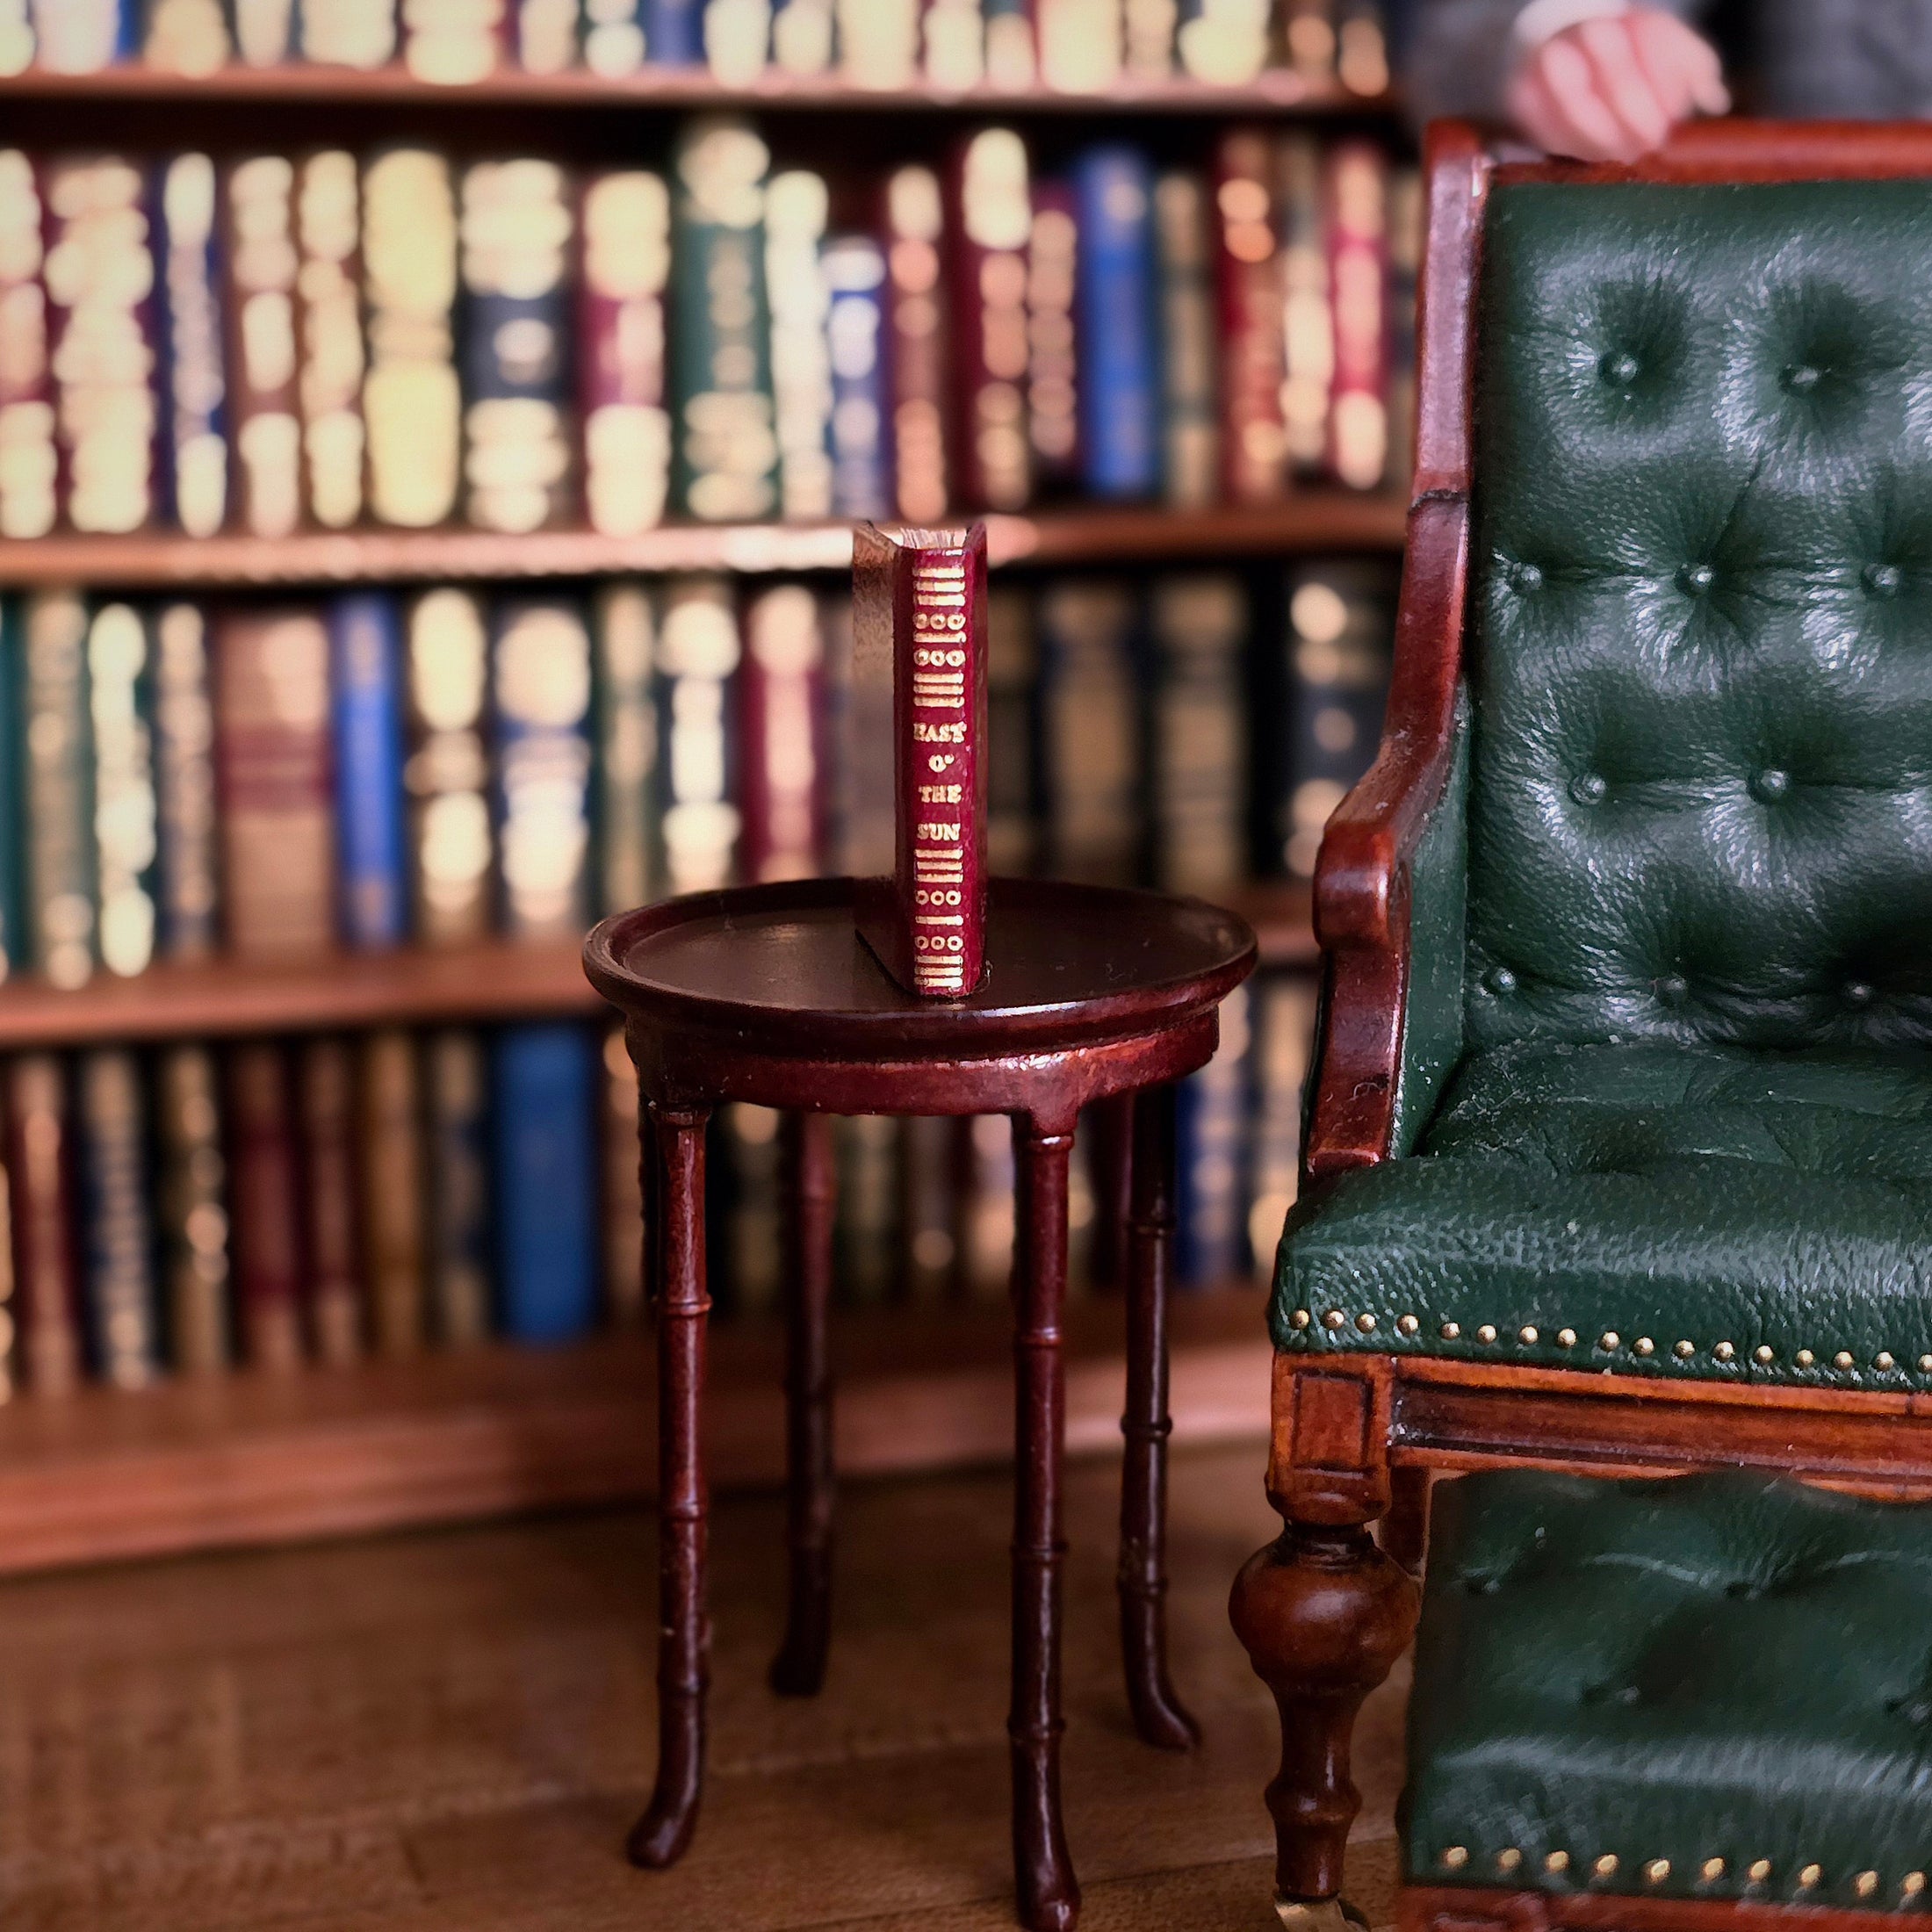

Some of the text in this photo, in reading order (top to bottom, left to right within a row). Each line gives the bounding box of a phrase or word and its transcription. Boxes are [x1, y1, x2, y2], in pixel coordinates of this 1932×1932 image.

[913, 721, 967, 743] EAST
[919, 784, 962, 804] THE
[917, 823, 961, 841] SUN
